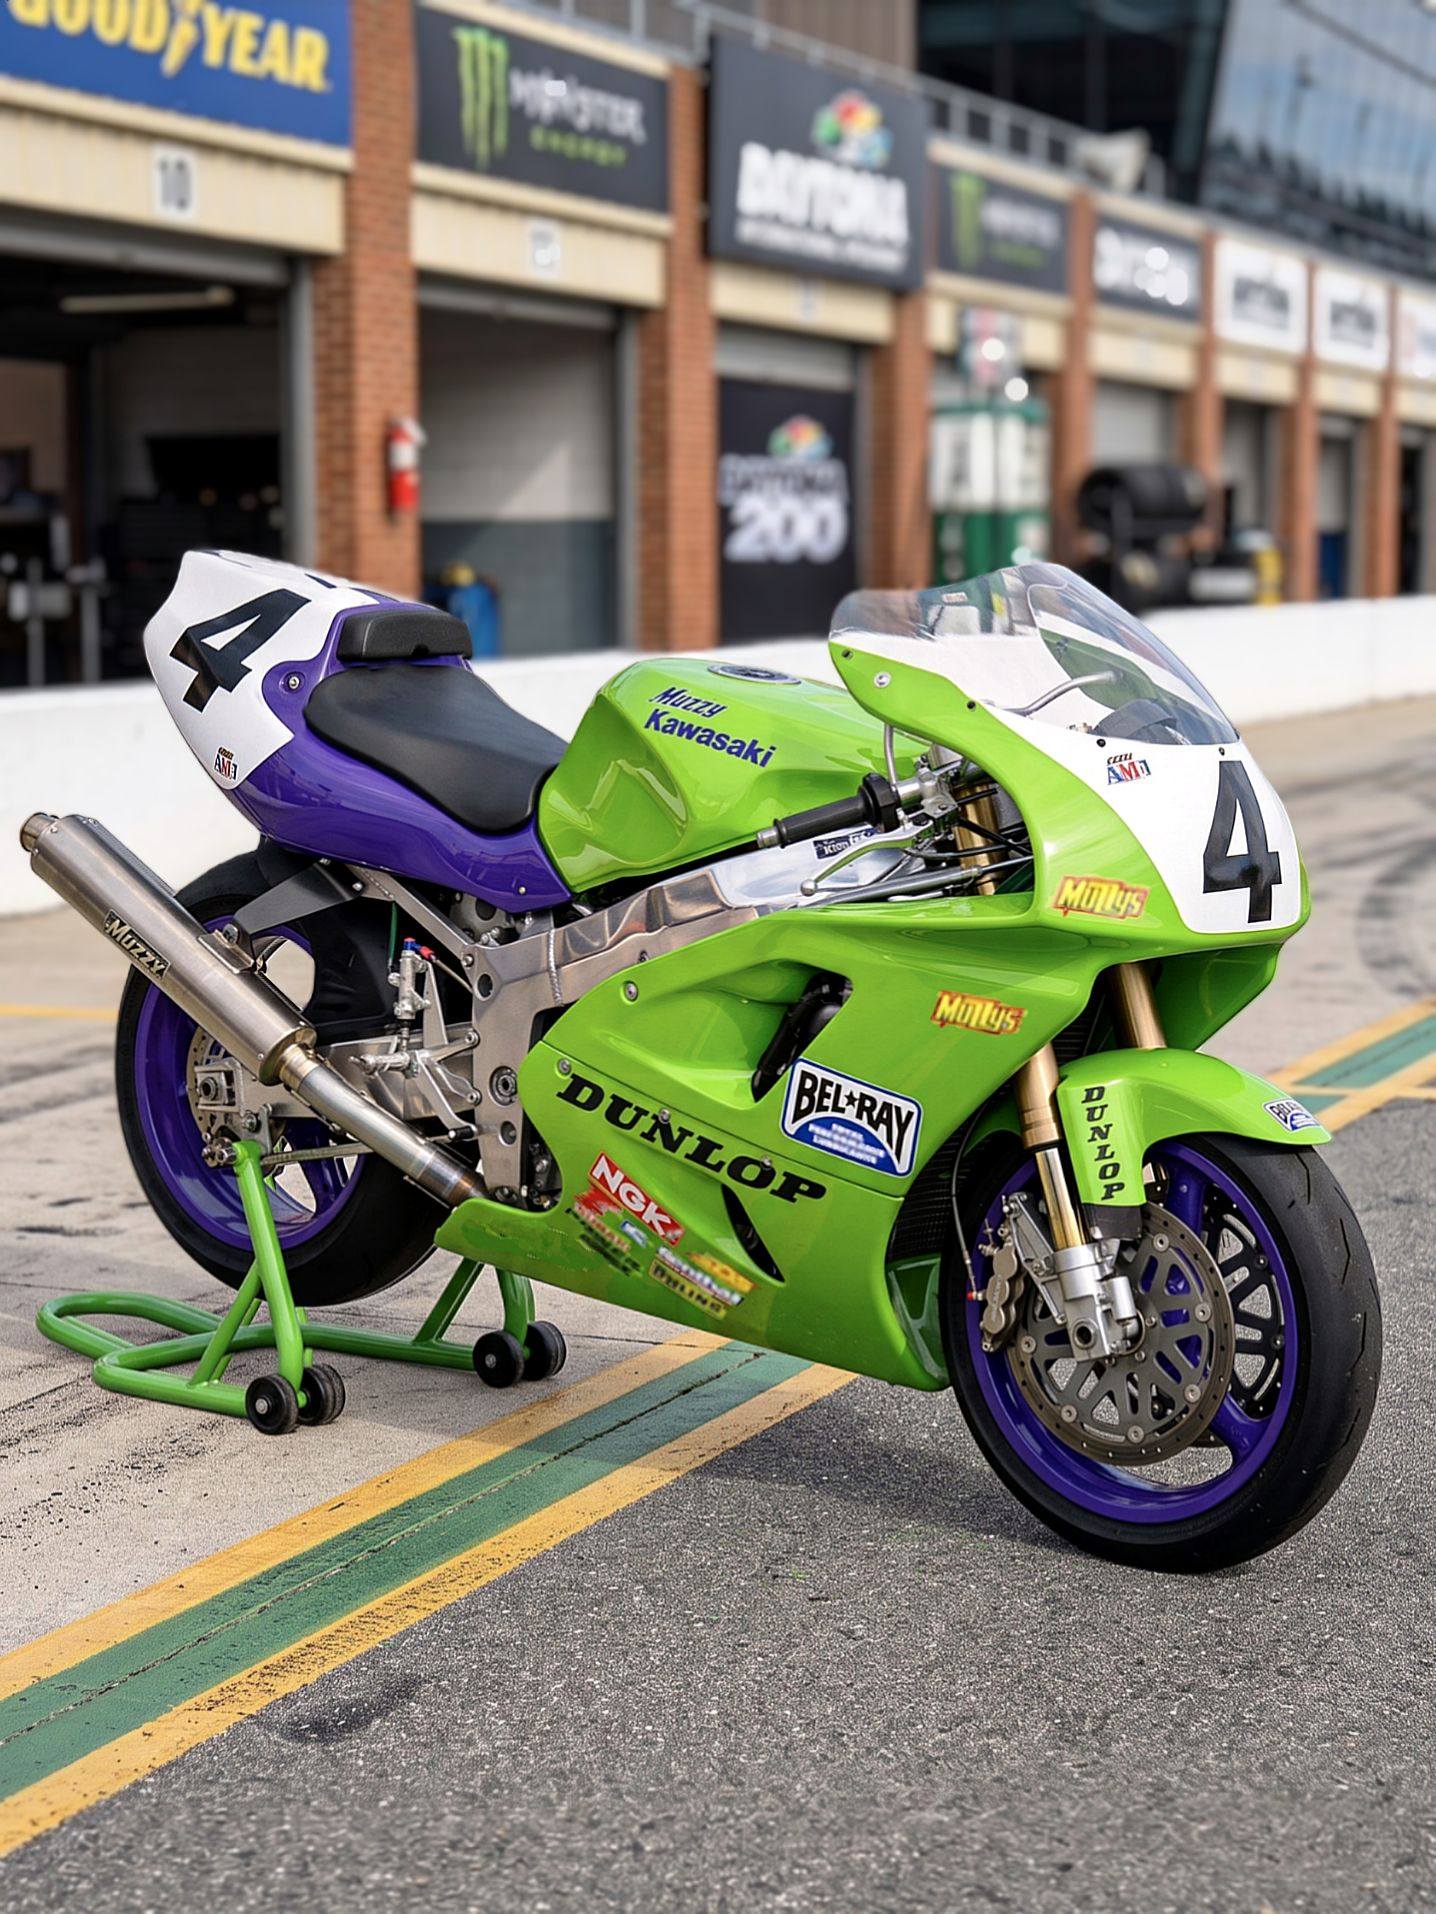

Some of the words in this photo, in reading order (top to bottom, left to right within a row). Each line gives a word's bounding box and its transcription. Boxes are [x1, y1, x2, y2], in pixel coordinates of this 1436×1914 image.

[724, 492, 849, 564] 200
[169, 588, 312, 713] 4
[644, 708, 777, 768] Kawasaki
[1202, 760, 1283, 924] 4
[556, 1073, 827, 1203] DUNLOP
[1081, 1085, 1126, 1201] DUNLOP
[592, 1155, 671, 1238] NGK
